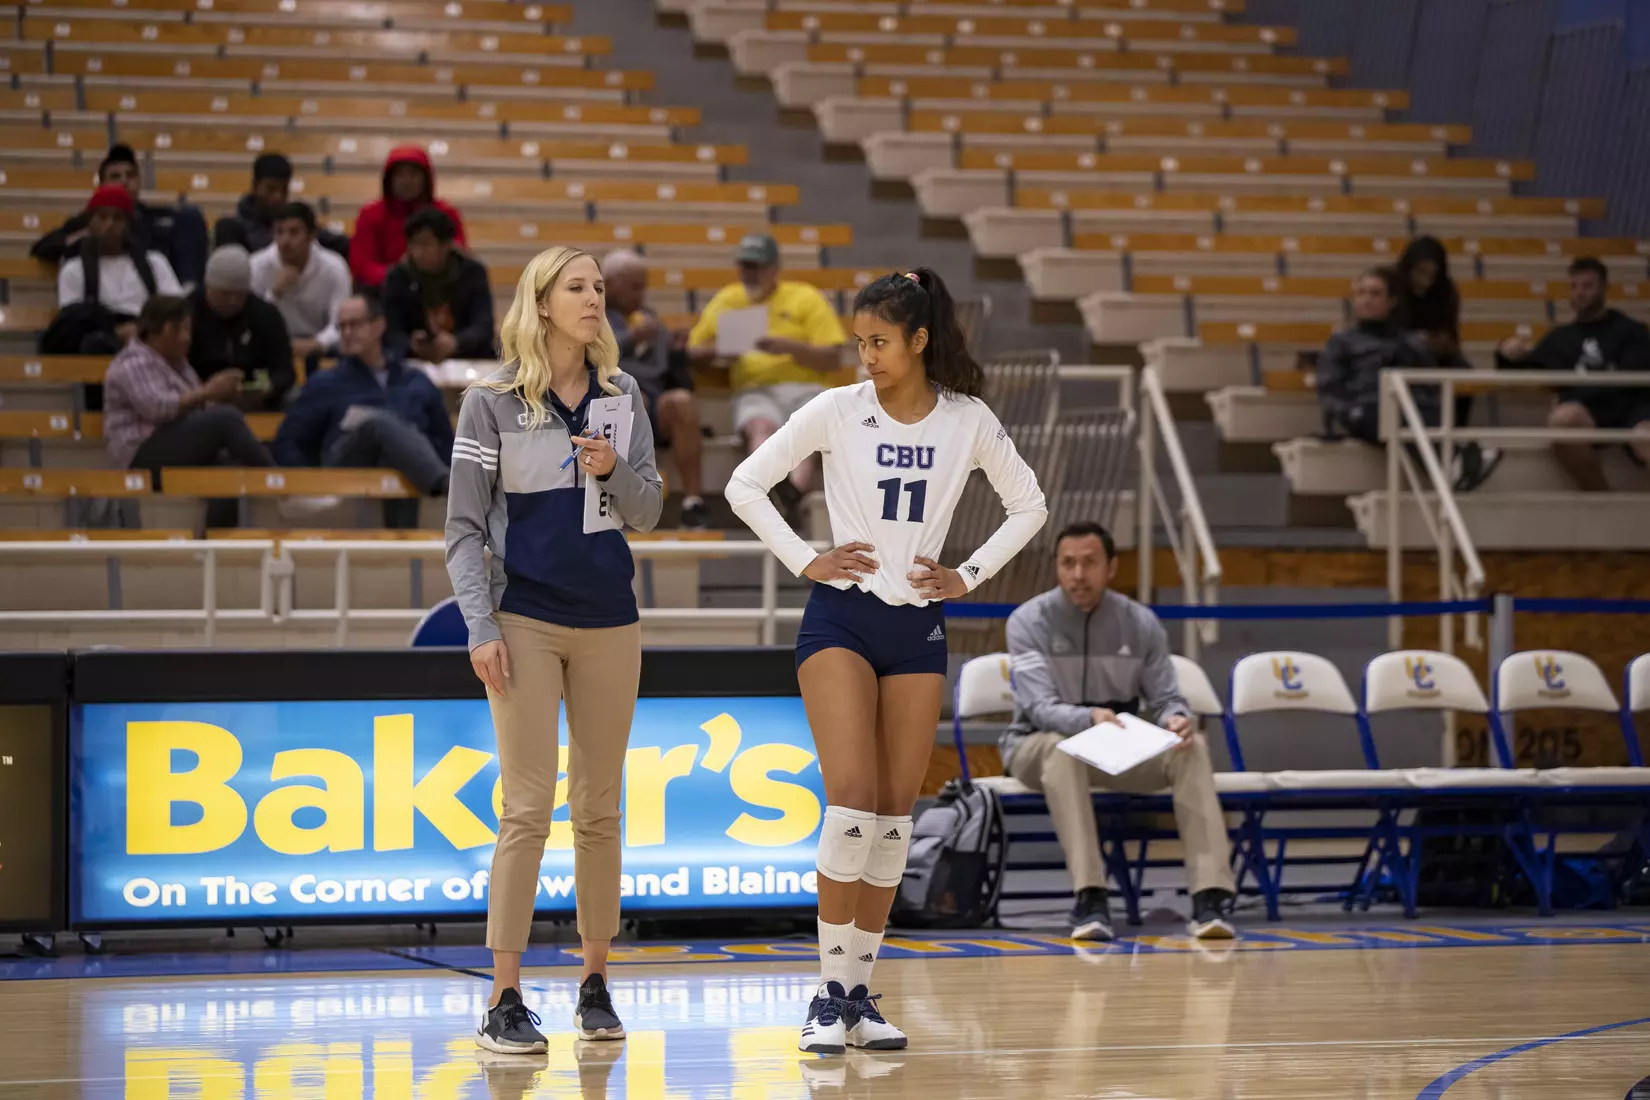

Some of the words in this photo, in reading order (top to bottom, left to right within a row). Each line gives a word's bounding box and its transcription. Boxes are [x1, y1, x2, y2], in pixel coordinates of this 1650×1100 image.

[876, 442, 936, 471] CBU
[877, 477, 928, 523] 11
[1518, 726, 1583, 762] 205
[123, 878, 187, 907] On
[200, 875, 278, 906] The
[289, 873, 431, 904] Corner
[442, 869, 489, 900] of
[702, 864, 818, 895] Blaine
